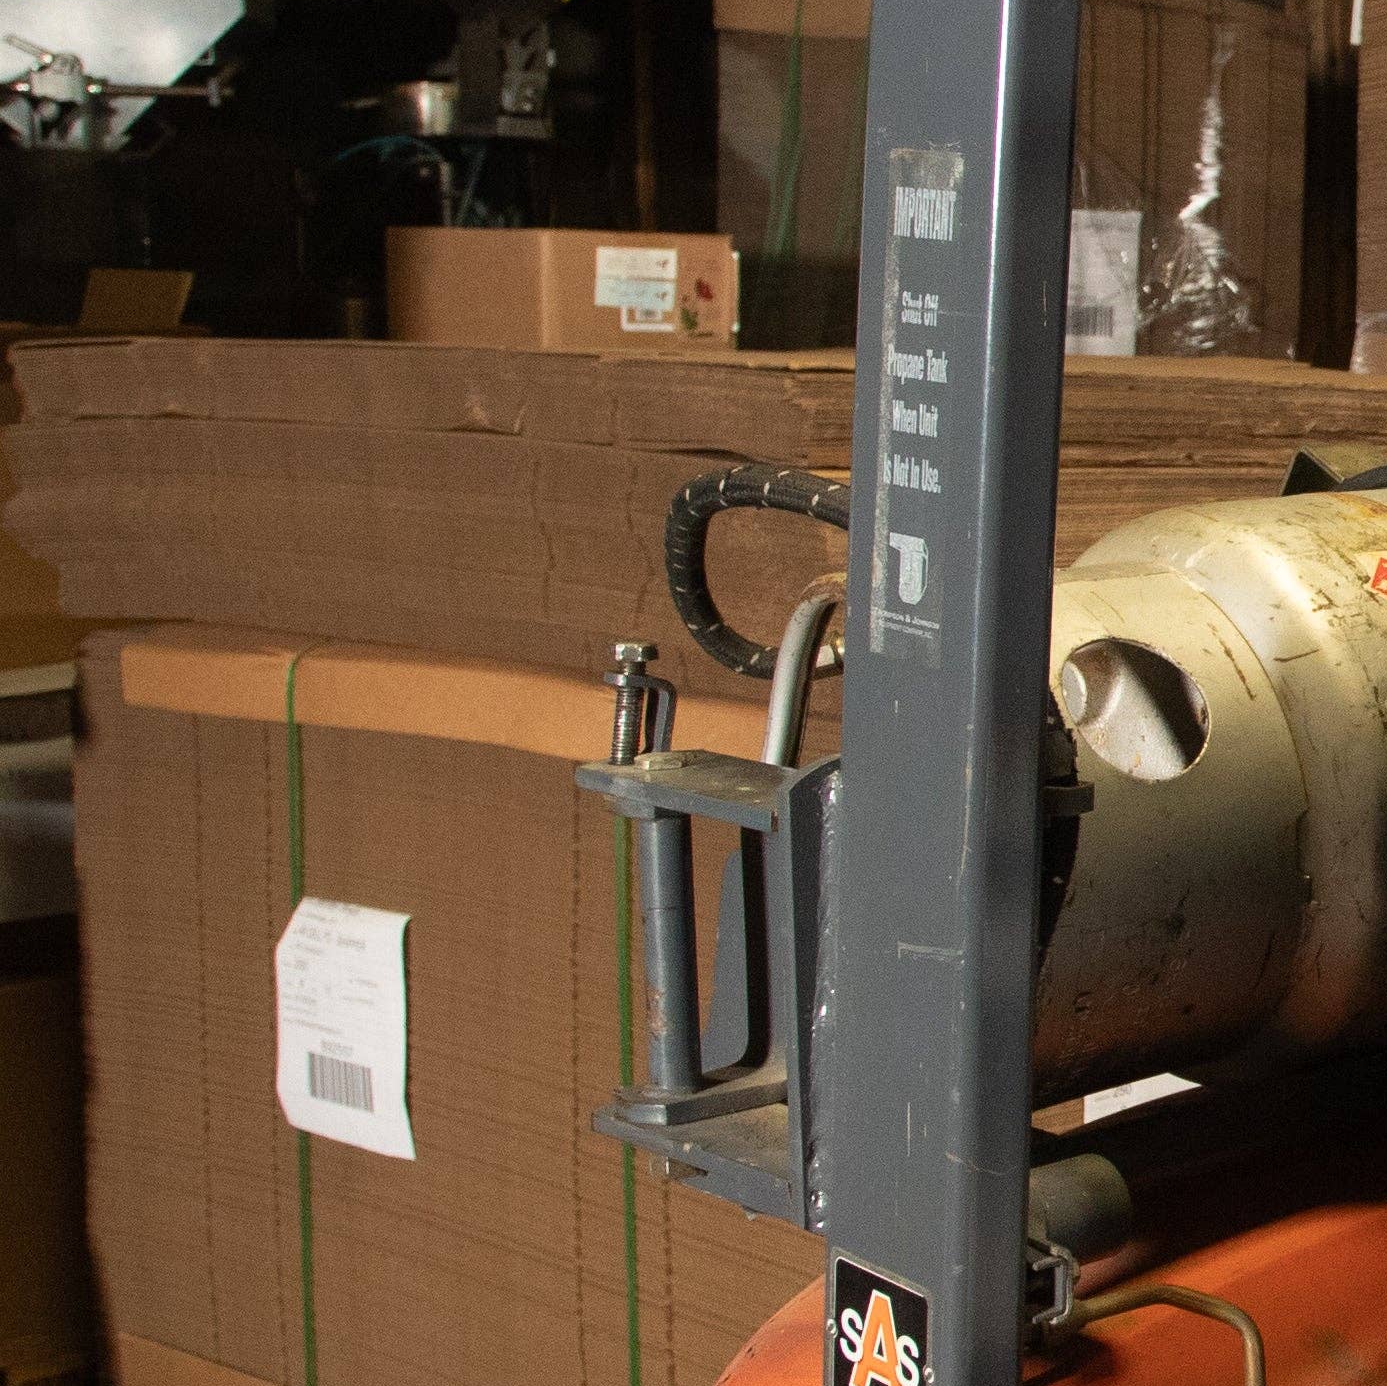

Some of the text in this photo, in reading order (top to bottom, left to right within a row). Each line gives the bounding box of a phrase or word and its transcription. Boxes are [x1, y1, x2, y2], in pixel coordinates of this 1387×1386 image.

[893, 186, 957, 241] IMPORTANT
[901, 290, 939, 327] Shut Off
[886, 343, 949, 385] Propane Tank
[892, 399, 939, 438] When Unit
[882, 452, 942, 494] Is Not In Use.
